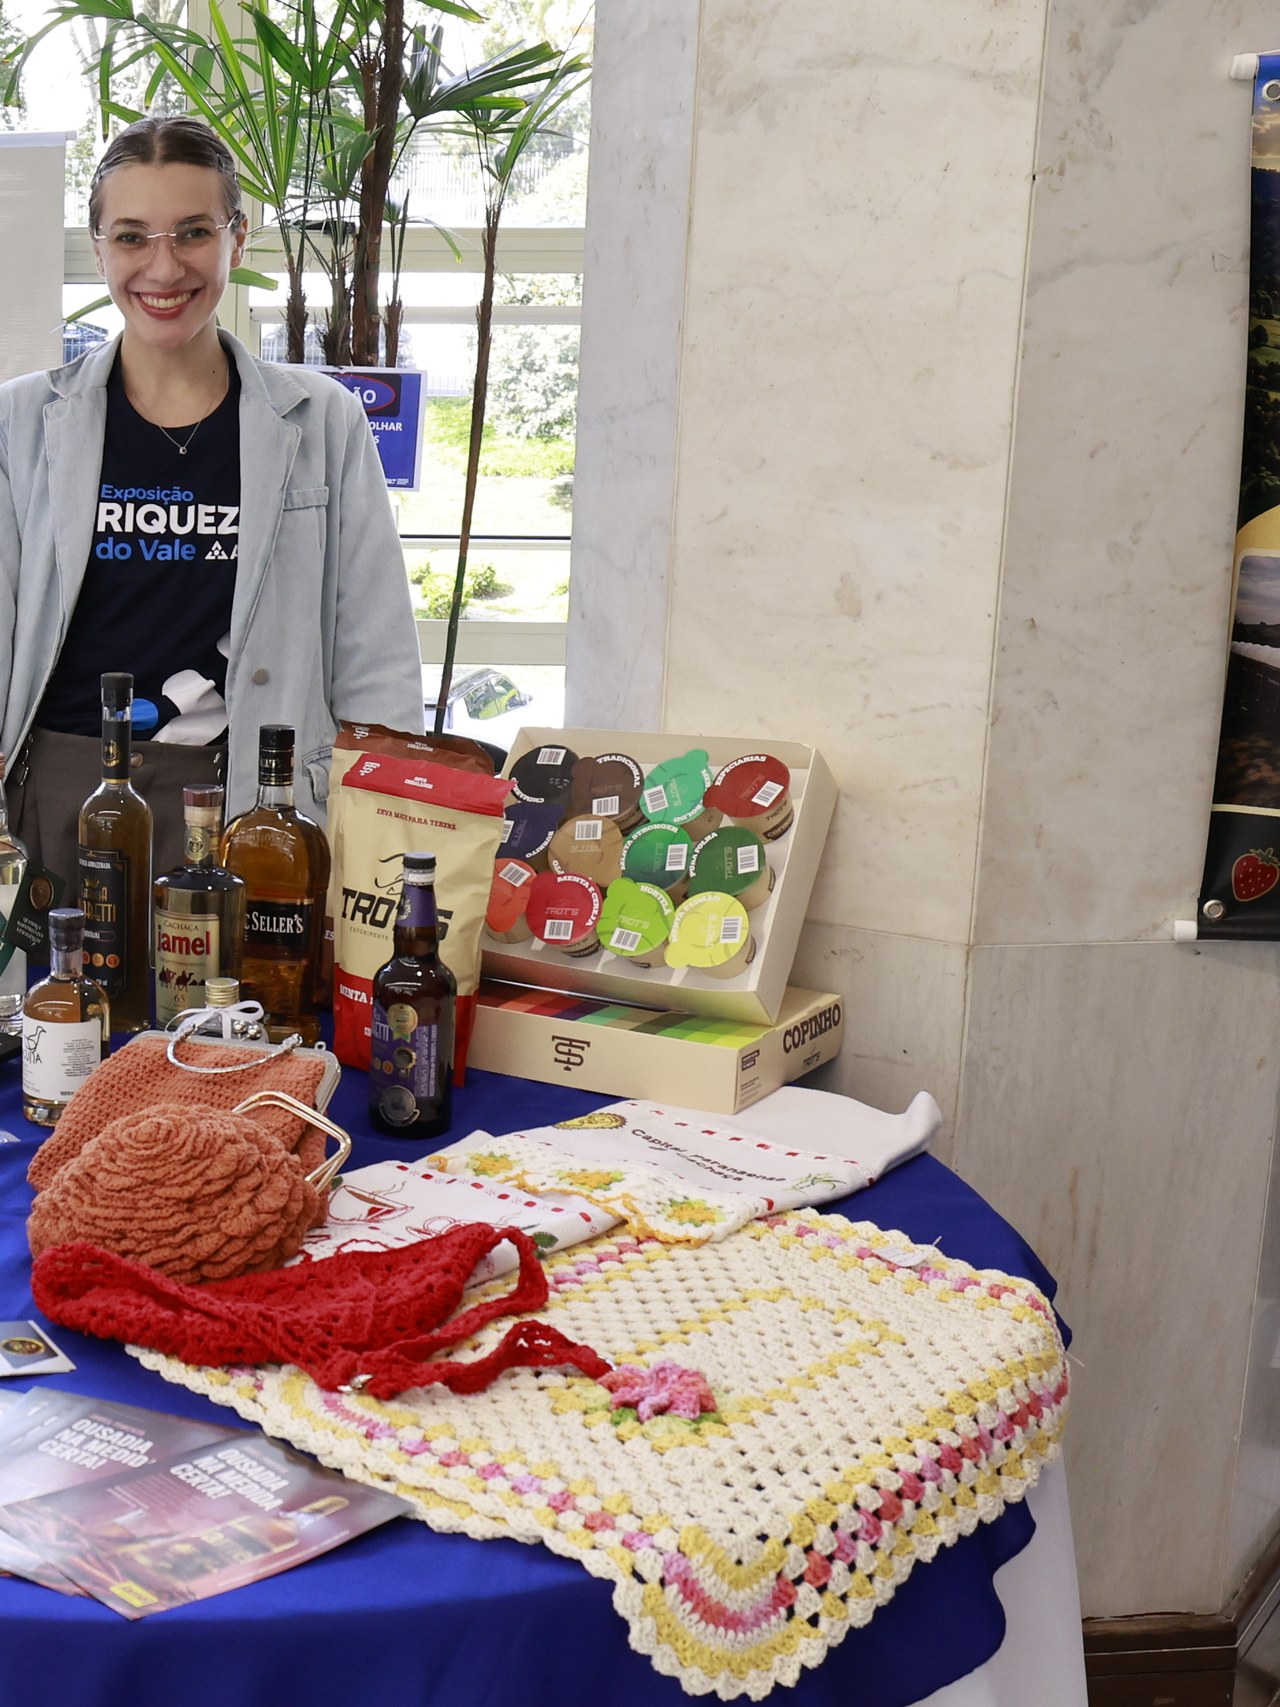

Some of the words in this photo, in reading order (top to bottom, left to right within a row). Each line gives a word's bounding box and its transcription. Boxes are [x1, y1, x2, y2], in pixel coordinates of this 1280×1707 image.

[369, 421, 403, 431] OLHAR
[100, 484, 194, 505] Exposição
[96, 502, 240, 535] RIQUEZ
[95, 537, 132, 560] do
[138, 538, 196, 561] Vale
[714, 755, 768, 786] ESPECIARIAS
[251, 910, 304, 934] SELLER'S
[342, 887, 454, 942] TROS
[324, 929, 334, 941] ES
[782, 1003, 841, 1054] COPINHO
[54, 1428, 83, 1450] NA
[85, 1438, 157, 1468] MEDID
[71, 1417, 154, 1455] OUSADIA
[38, 1438, 109, 1470] CERTA!
[217, 1447, 290, 1492] OUSADIA
[170, 1462, 233, 1500] CERTA!
[193, 1455, 216, 1476] NA
[215, 1466, 285, 1513] MEDIDA
